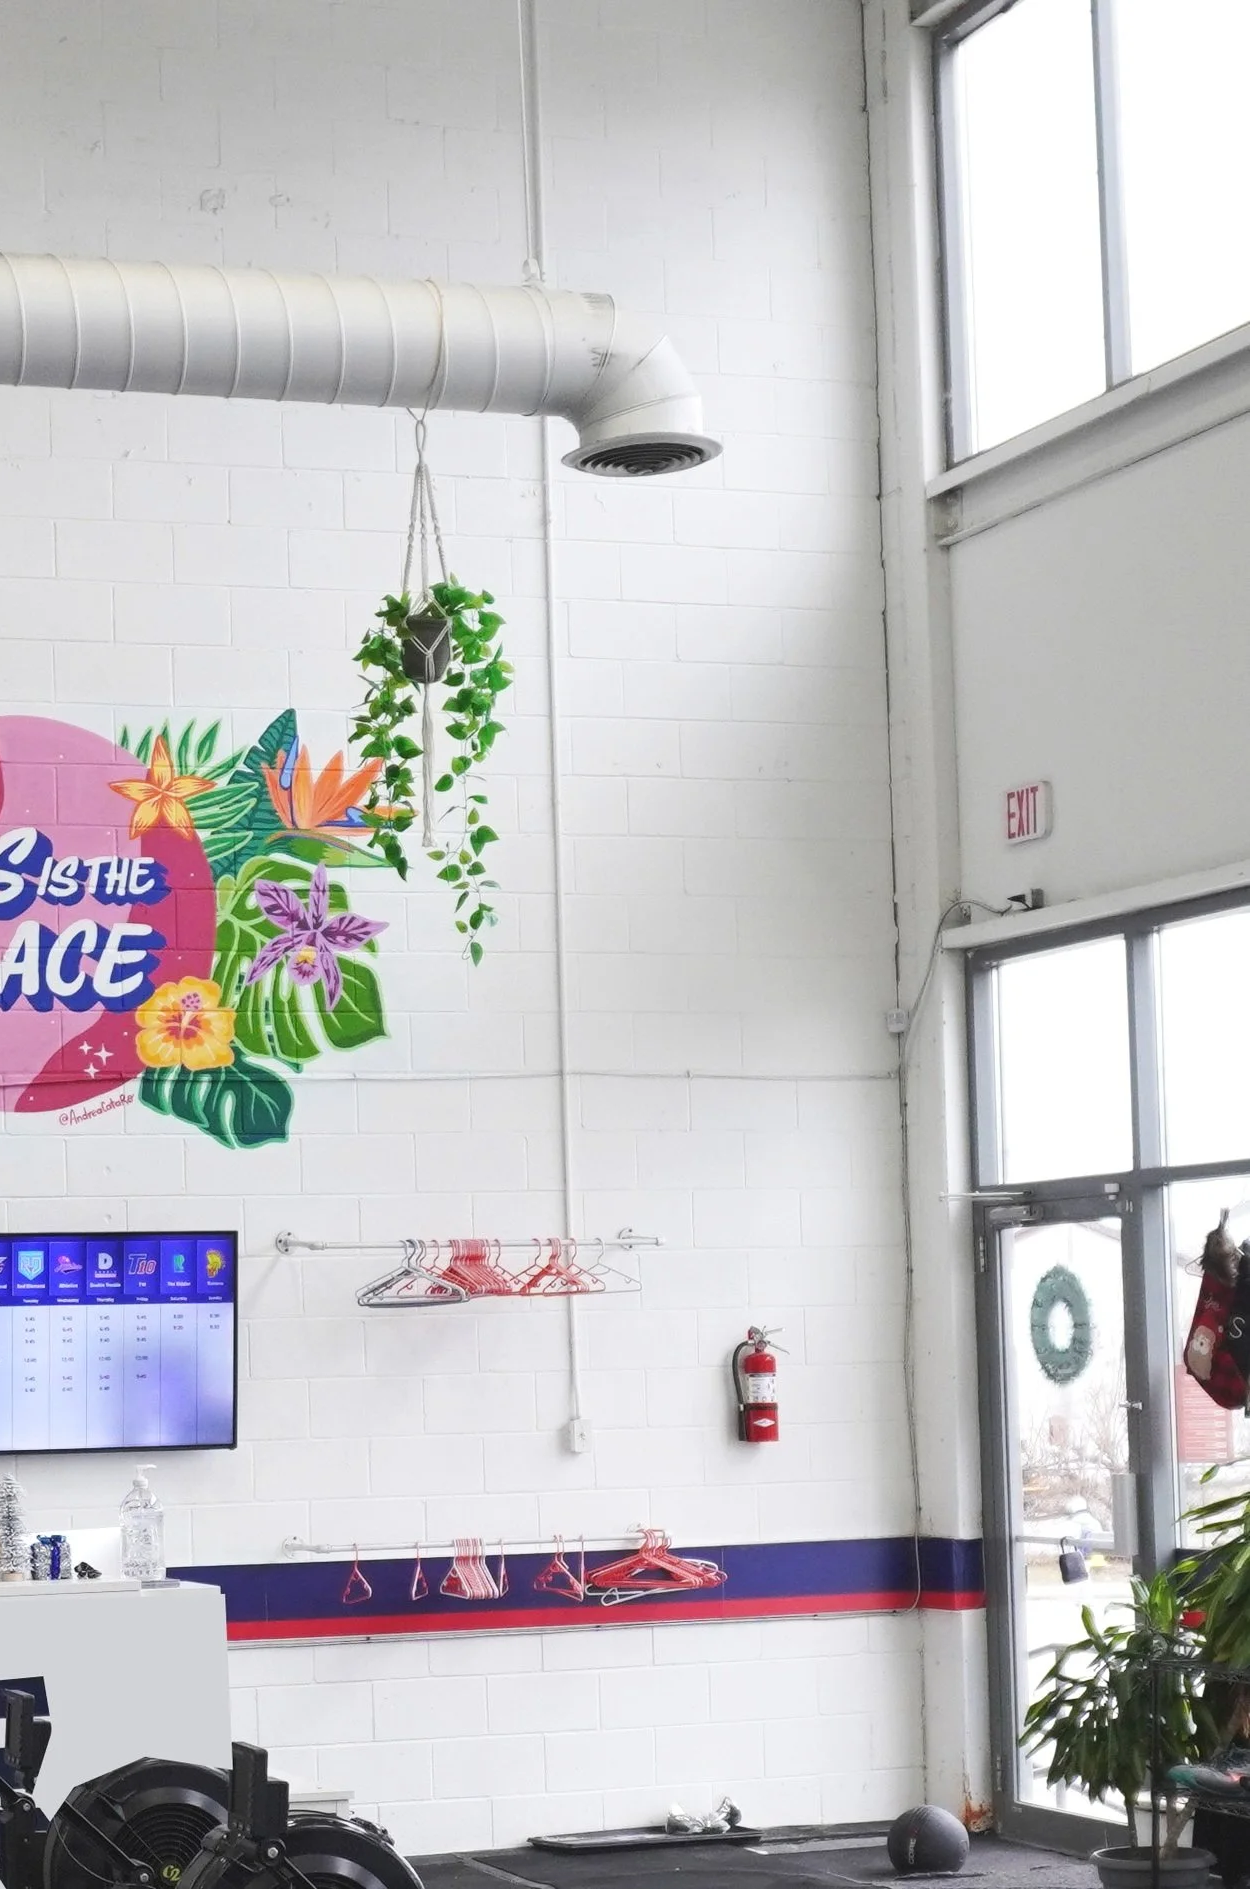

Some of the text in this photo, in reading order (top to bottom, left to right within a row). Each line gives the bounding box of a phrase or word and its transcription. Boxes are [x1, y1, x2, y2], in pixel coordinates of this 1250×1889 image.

[1007, 786, 1038, 839] EXIT
[36, 856, 81, 899] IS
[82, 856, 160, 899] THE
